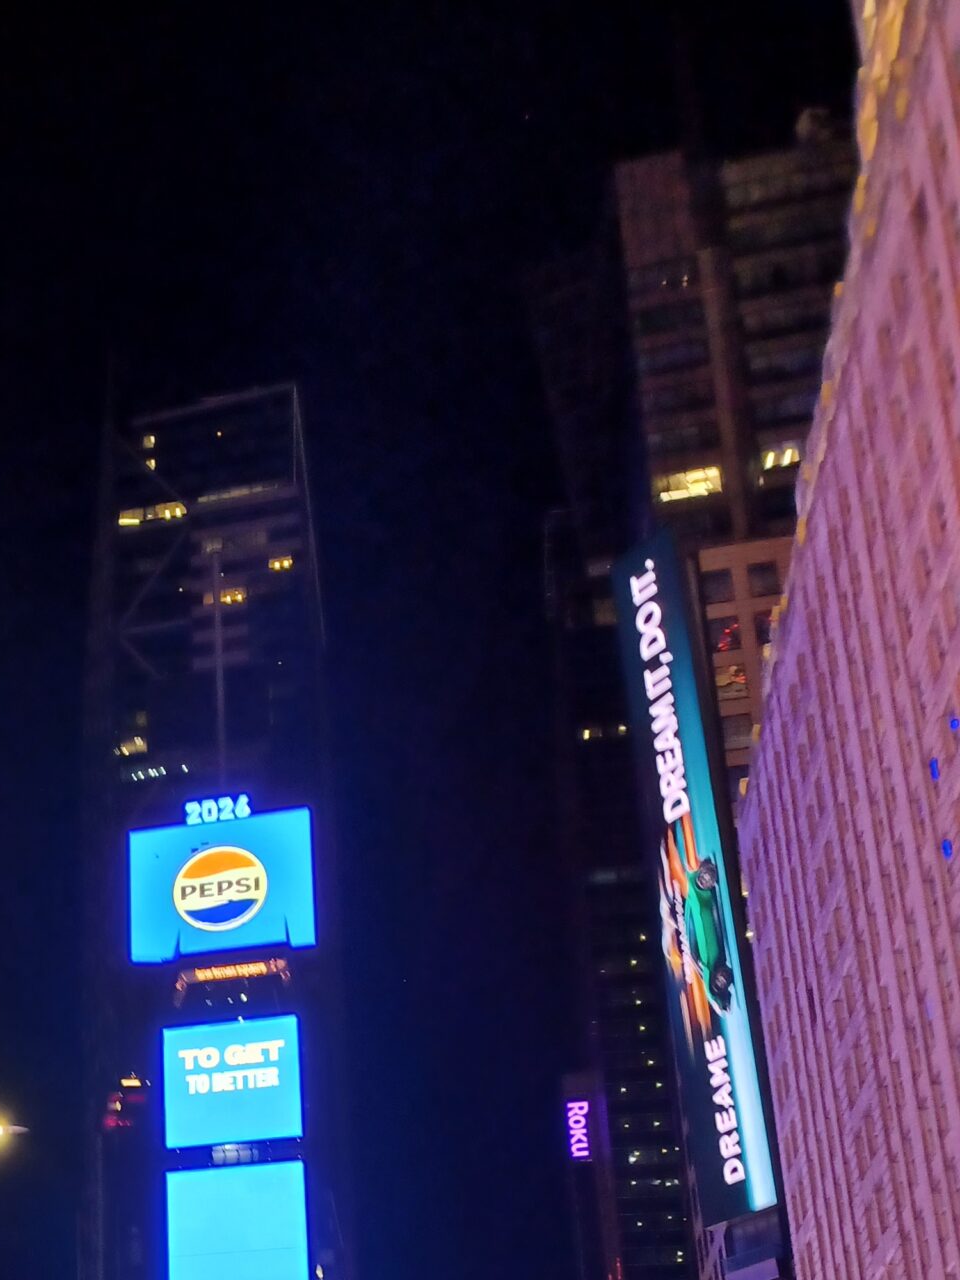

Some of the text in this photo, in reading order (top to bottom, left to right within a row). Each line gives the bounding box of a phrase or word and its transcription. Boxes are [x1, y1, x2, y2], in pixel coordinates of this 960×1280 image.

[184, 793, 252, 826] 2026
[179, 872, 262, 901] PEPSI
[178, 1039, 286, 1070] TO GET
[185, 1067, 280, 1095] TO BETTER
[704, 1034, 746, 1186] DREAME
